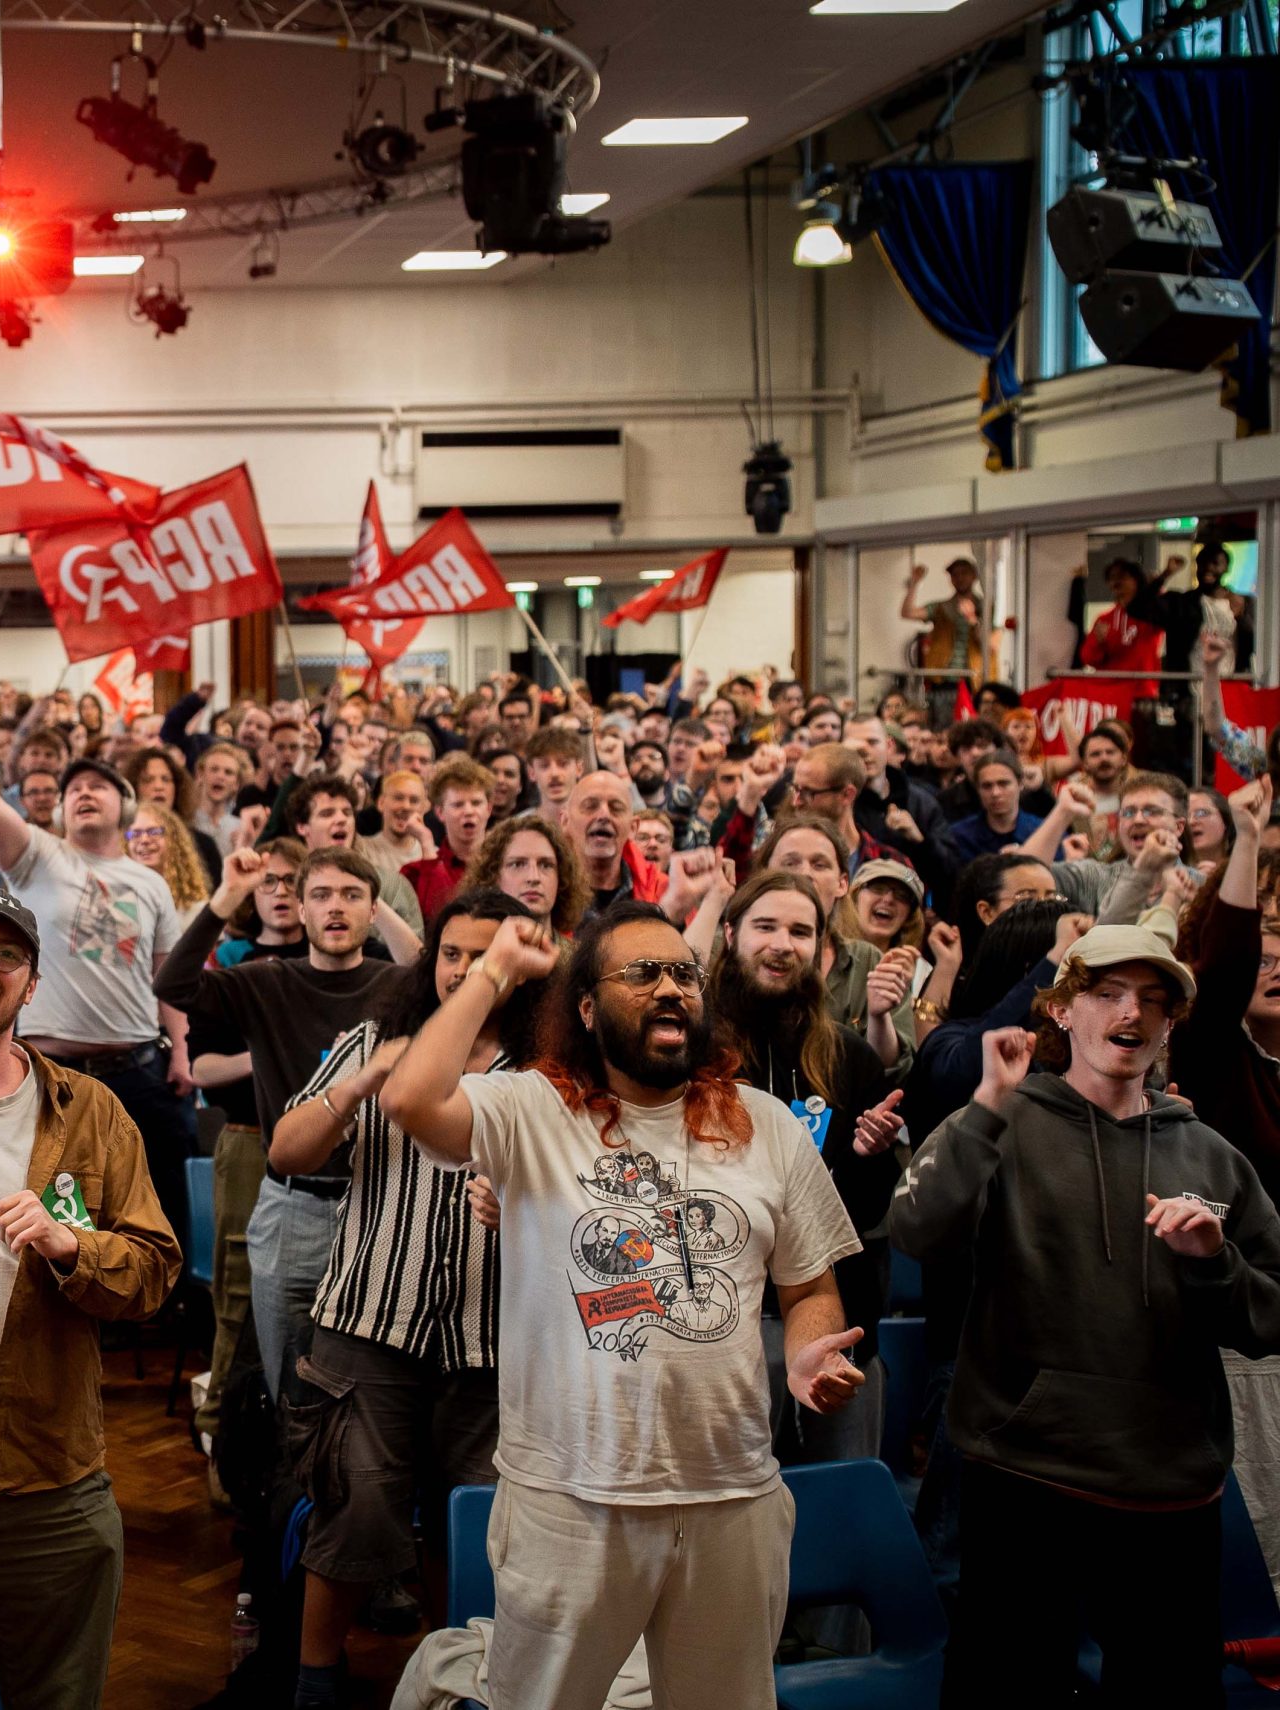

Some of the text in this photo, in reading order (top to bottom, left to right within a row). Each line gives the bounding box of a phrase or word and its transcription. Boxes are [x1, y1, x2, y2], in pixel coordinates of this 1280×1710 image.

[656, 1237, 681, 1255] SEGUND
[690, 1244, 741, 1261] NTERNACIONAL
[592, 1270, 626, 1284] TERCERA
[627, 1266, 684, 1283] INTERNACIONAL
[666, 1322, 691, 1337] CUARTA
[587, 1331, 649, 1359] 2024
